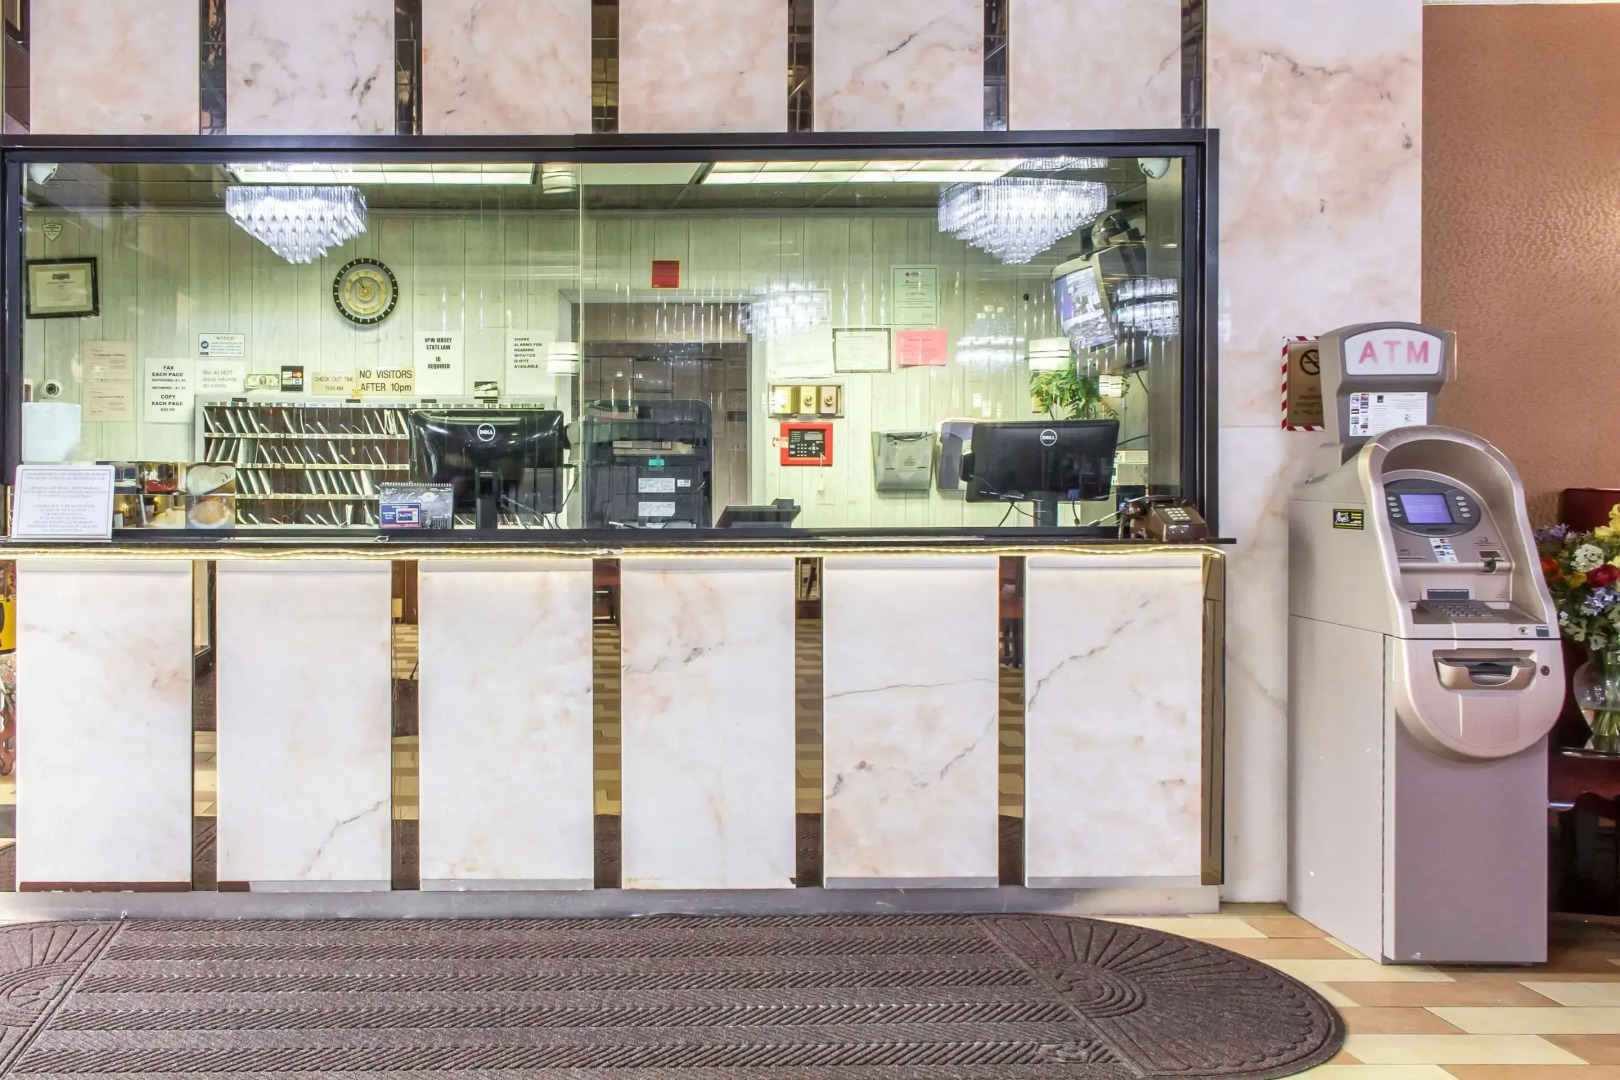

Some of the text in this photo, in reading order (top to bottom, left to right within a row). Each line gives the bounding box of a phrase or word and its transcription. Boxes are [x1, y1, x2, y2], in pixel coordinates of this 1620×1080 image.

[1358, 340, 1429, 364] ATM
[359, 370, 413, 379] NO VISITORS
[360, 382, 412, 393] AFTER 10pm
